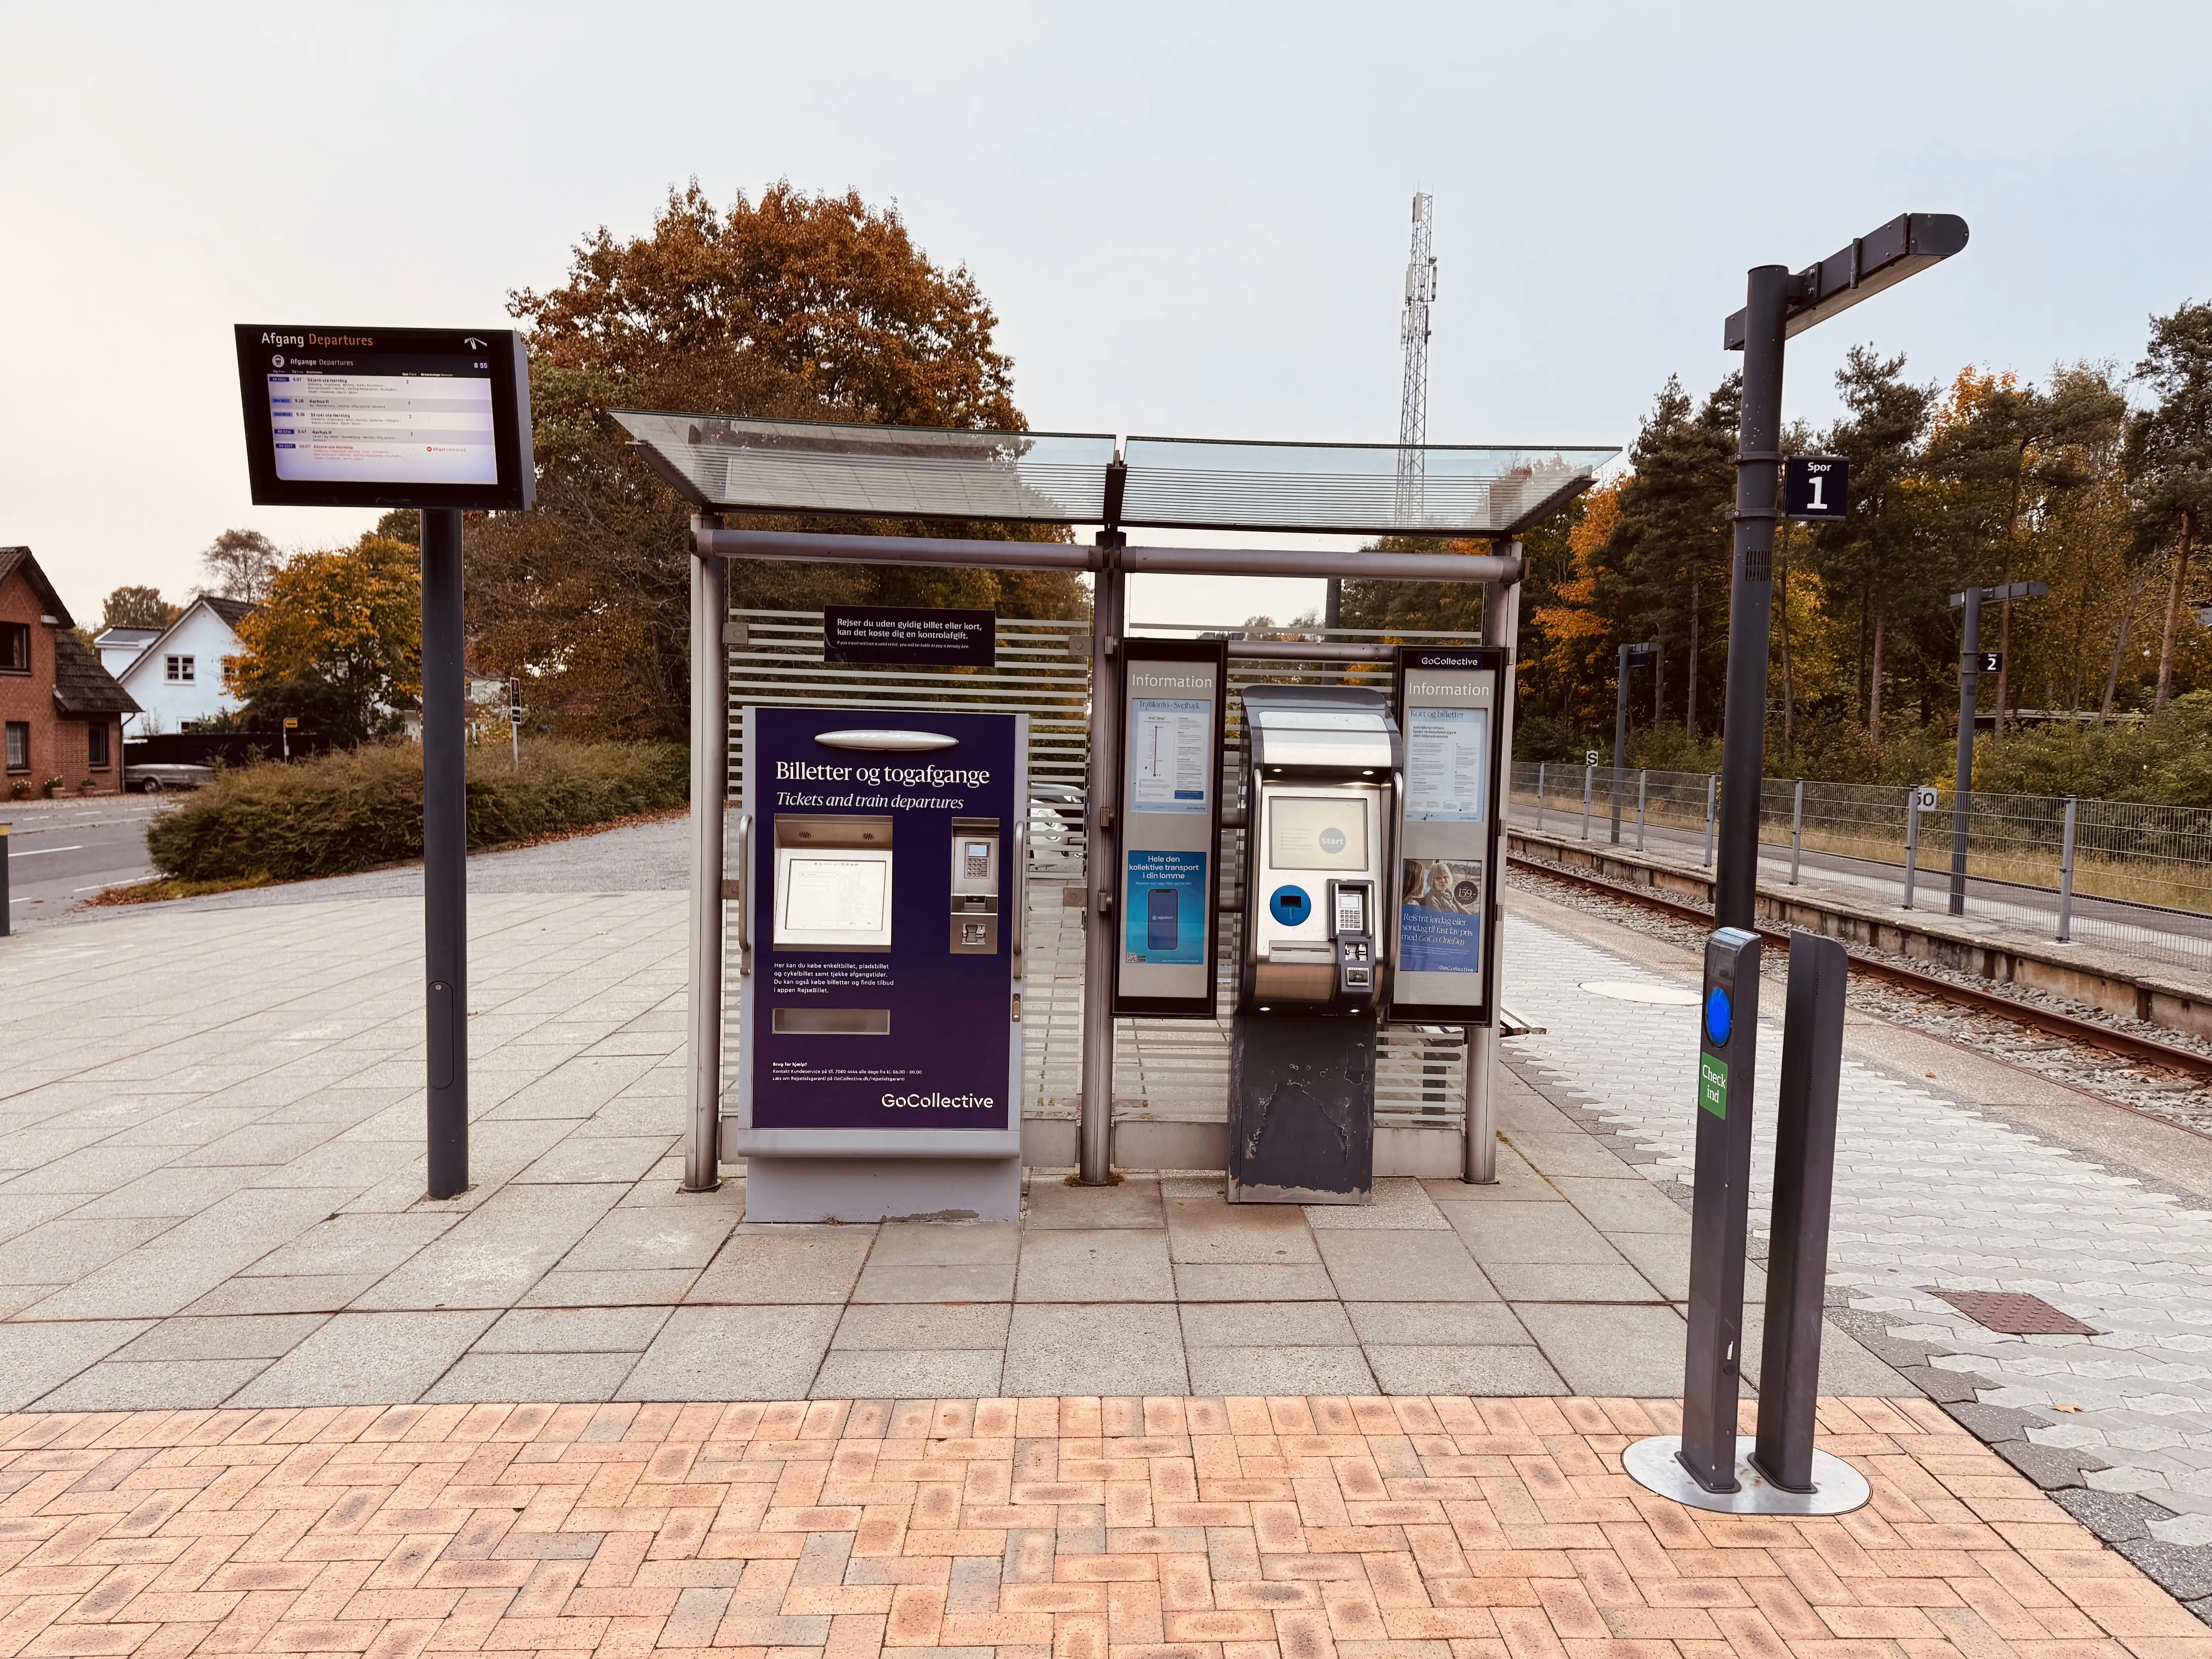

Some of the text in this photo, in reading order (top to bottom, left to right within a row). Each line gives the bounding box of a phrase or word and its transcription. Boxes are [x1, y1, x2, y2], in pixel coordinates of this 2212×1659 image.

[262, 333, 373, 347] Afgang Departures
[1807, 462, 1832, 472] Spor
[1807, 477, 1827, 509] 1
[838, 618, 861, 627] Rejser
[898, 621, 921, 629] gyldig
[964, 622, 982, 630] kort,
[892, 630, 904, 638] dig
[919, 630, 968, 640] kontrolafgift.
[1422, 658, 1478, 666] GoCollective
[1987, 658, 1996, 670] 2
[1133, 674, 1212, 688] Information
[1409, 682, 1489, 696] Information
[1588, 753, 1597, 764] S
[776, 761, 990, 788] Billetter og togafgange
[777, 792, 964, 810] Tickets and train departures
[1459, 888, 1476, 898] 159,-
[1404, 914, 1417, 922] Rejs
[1430, 915, 1451, 926] lørdag
[1403, 924, 1427, 934] søndag
[1437, 926, 1448, 934] fast
[1419, 934, 1437, 943] GoCo
[1439, 936, 1467, 946] OneDay
[1702, 1064, 1726, 1089] Check
[1707, 1084, 1719, 1104] ind
[881, 1093, 993, 1108] GoCollective
